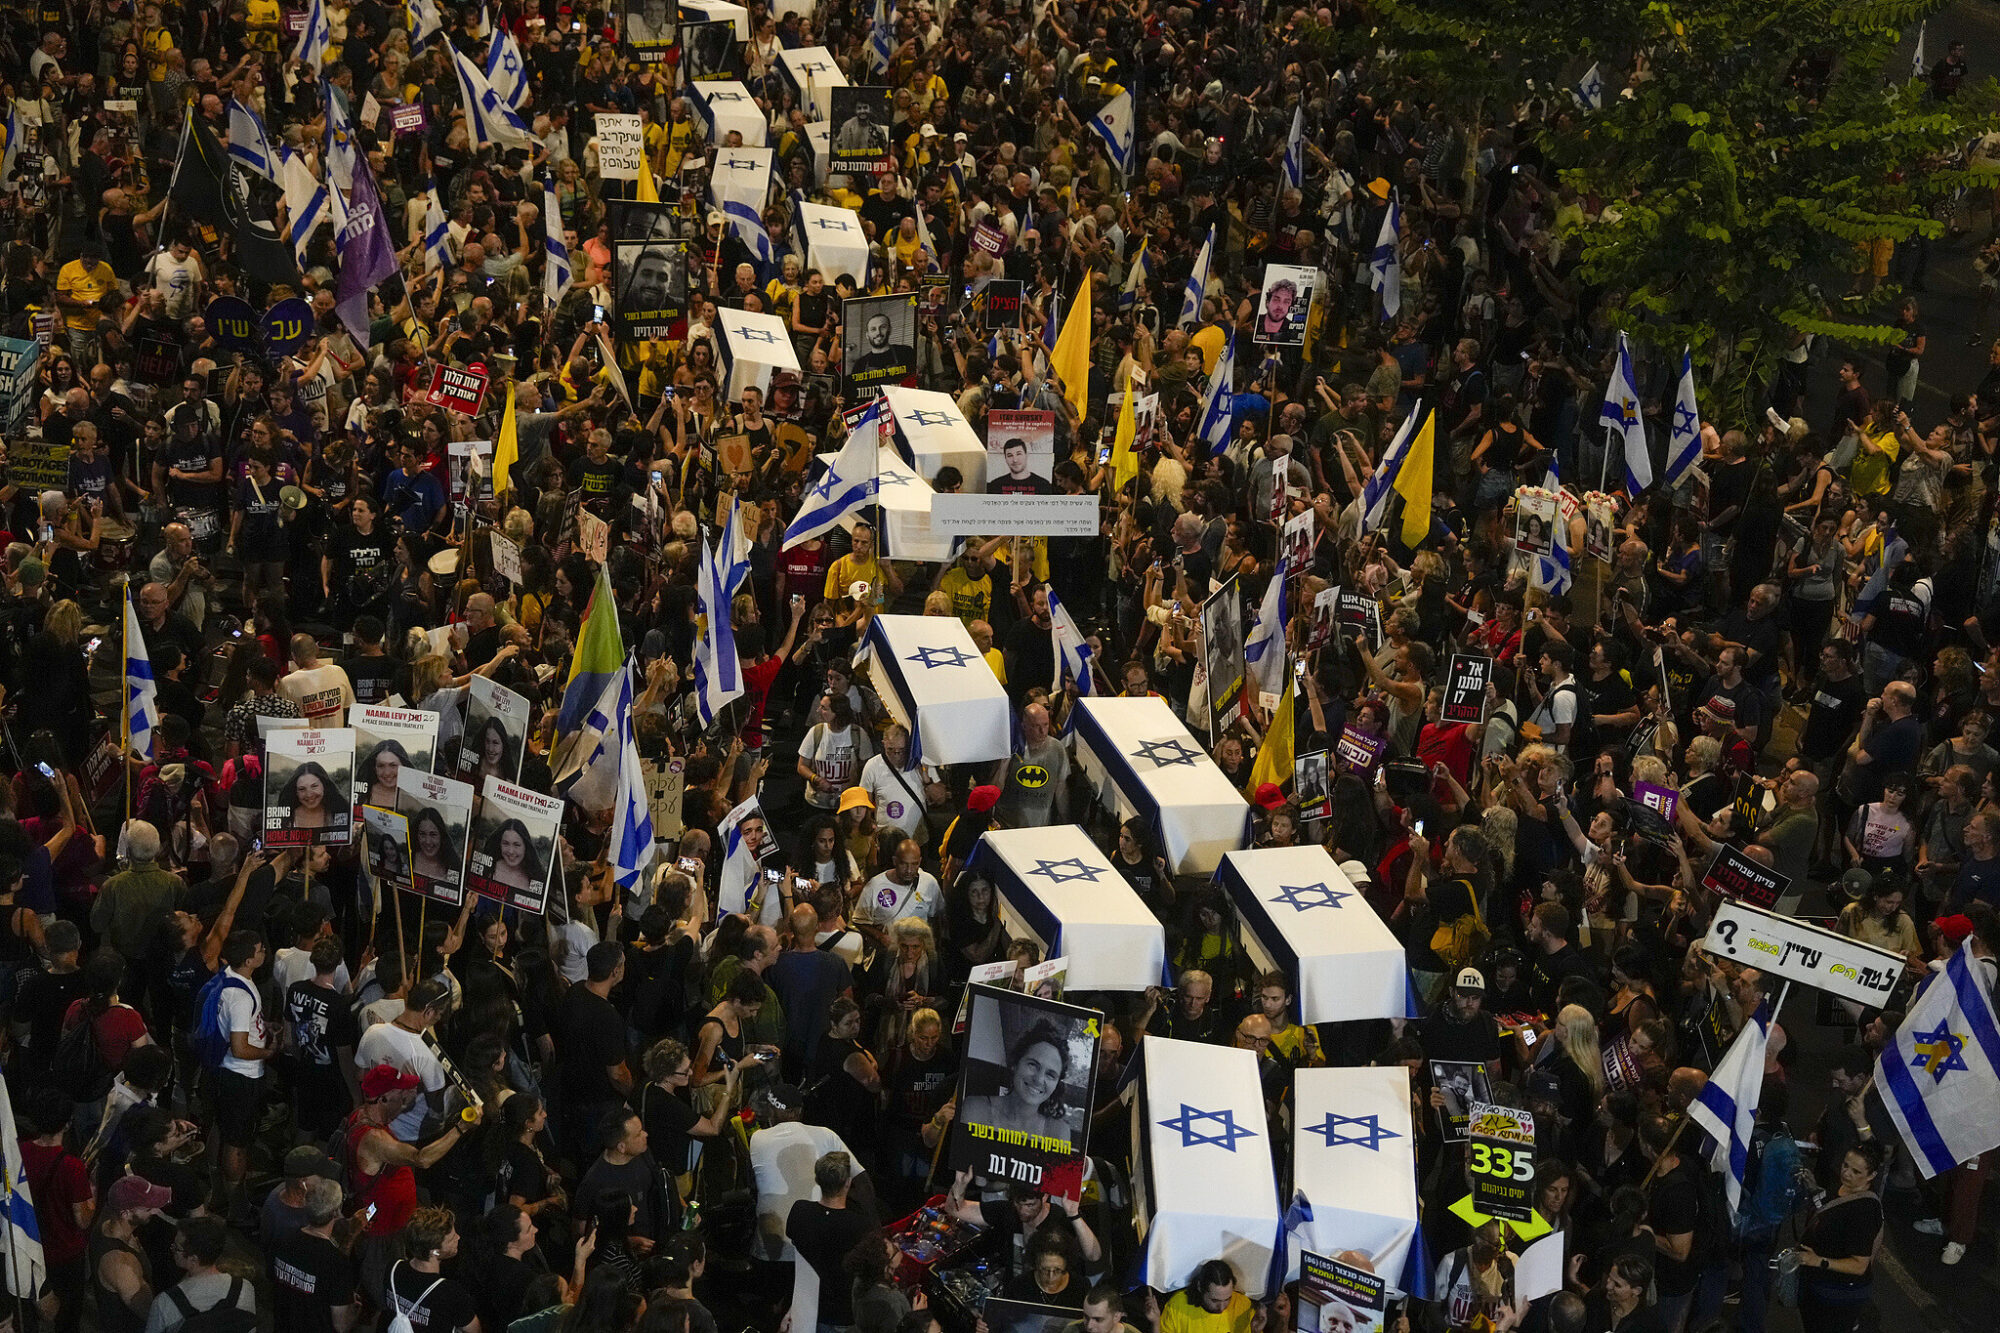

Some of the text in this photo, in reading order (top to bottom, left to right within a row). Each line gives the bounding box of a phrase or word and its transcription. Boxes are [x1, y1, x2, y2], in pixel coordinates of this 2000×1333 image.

[599, 118, 622, 128] אתה
[600, 132, 641, 145] שתקריב
[602, 158, 641, 170] שלהם?
[873, 161, 888, 171] הרש
[991, 296, 1019, 311] הצילו
[443, 369, 482, 391] אות קלון
[442, 384, 477, 402] ואות קין
[350, 547, 381, 559] הלילה
[356, 558, 375, 566] הזה
[1341, 594, 1359, 605] אש
[1468, 661, 1483, 677] אל
[1457, 675, 1483, 690] תתנו
[1453, 690, 1466, 704] לו
[366, 708, 390, 719] NAAMA
[390, 711, 408, 721] LEVY
[1447, 704, 1479, 718] להקריב
[366, 718, 379, 727] PEACE
[296, 738, 326, 747] NAAMA LEVY
[461, 747, 480, 766] BRING
[1337, 740, 1371, 765] עכשיו
[460, 758, 472, 774] HER
[816, 760, 852, 781] עכשיו
[355, 781, 369, 794] ING
[496, 783, 518, 800] NAAMA
[518, 790, 534, 803] LEVY
[267, 806, 291, 818] BRING
[266, 818, 282, 830] HER
[266, 829, 313, 843] HOME NOW!
[472, 850, 494, 869] BRING
[470, 861, 485, 877] HER
[1728, 858, 1776, 889] פדיון שבויים
[1717, 864, 1750, 891] מחיר
[1750, 882, 1776, 904] בכל
[1717, 919, 1896, 992] למה הם עדיין ?
[1503, 1109, 1516, 1119] רק
[1516, 1112, 1532, 1122] הם
[1485, 1115, 1517, 1130] לא
[967, 1122, 1071, 1156] הופקרה למוות בשבי
[1520, 1133, 1534, 1144] הם
[988, 1153, 1043, 1185] כרמל גת
[1470, 1143, 1535, 1182] 335
[1480, 1182, 1526, 1200] ימים בגיהנום
[1307, 1265, 1377, 1297] מוחזק בשבי החמאס
[1333, 1266, 1358, 1282] מנצור
[1324, 1281, 1351, 1296] באוקטובר
[1357, 1275, 1382, 1289] שלמה
